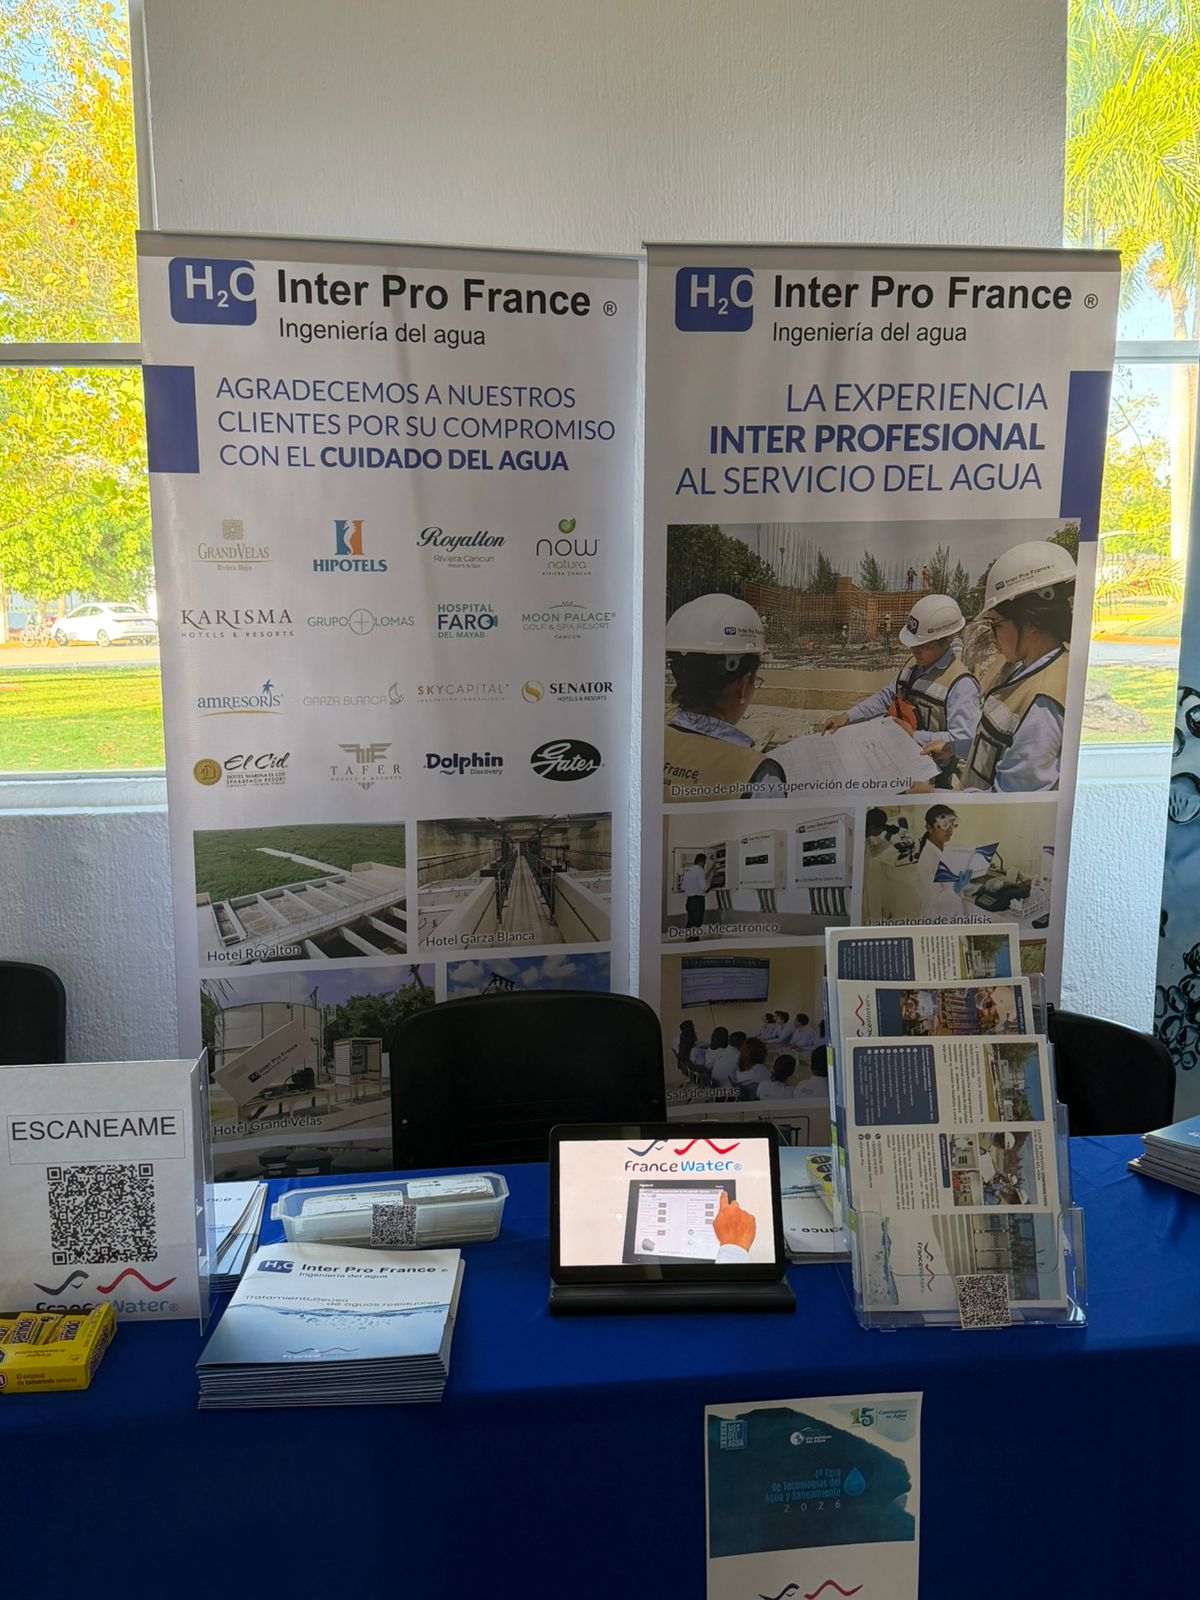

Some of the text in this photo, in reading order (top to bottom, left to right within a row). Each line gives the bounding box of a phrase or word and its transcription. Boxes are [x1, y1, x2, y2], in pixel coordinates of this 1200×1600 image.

[278, 269, 368, 307] Inter
[383, 274, 448, 310] Pro
[464, 278, 591, 316] France
[774, 274, 858, 310] Inter
[871, 275, 934, 309] Pro
[948, 276, 1073, 310] France
[279, 317, 486, 349] Ingeniería del agua
[773, 321, 967, 347] Ingeniería del agua
[216, 377, 576, 408] AGRADECEMOS A NUESTROS
[786, 382, 1049, 412] LA EXPERIENCIA
[218, 411, 616, 441] CLIENTES POR SU COMPROMISO
[710, 422, 1046, 454] INTER PROFESIONAL
[219, 444, 569, 471] CON EL CUIDADO DEL AGUA
[675, 462, 1042, 495] AL SERVICIO DEL AGUA
[417, 527, 505, 552] Royalton
[536, 538, 598, 556] now
[312, 559, 388, 573] HIPOTELS
[548, 560, 586, 569] natura
[438, 604, 493, 613] HOSPITAL
[522, 613, 560, 622] MOON
[181, 609, 293, 630] KARISMA
[308, 615, 415, 627] GRUPO LOMAS
[438, 614, 494, 630] FARO
[438, 631, 454, 639] DEL
[549, 681, 614, 695] SENATOR
[303, 695, 387, 706] GARZA BLANCA
[224, 755, 253, 770] El
[426, 752, 503, 775] Dolphin
[532, 743, 600, 777] Gates
[330, 764, 401, 776] TAFER
[713, 783, 727, 795] de
[729, 782, 765, 796] planos
[768, 783, 775, 793] y
[777, 778, 843, 794] supervición
[846, 778, 860, 789] de
[862, 777, 887, 789] obra
[890, 776, 912, 788] civil
[709, 921, 778, 934] Mecatrónico
[934, 914, 947, 924] de
[950, 913, 991, 924] análisis
[426, 930, 535, 947] Hotel Garza Blanca
[207, 944, 301, 962] Hotel Royalton
[667, 1085, 740, 1100] Sala de juntas
[11, 1116, 176, 1140] ESCANEAME
[213, 1116, 322, 1136] Hotel Grand Velas
[302, 1263, 342, 1273] Inter
[380, 1266, 436, 1274] France
[849, 1407, 875, 1427] 15
